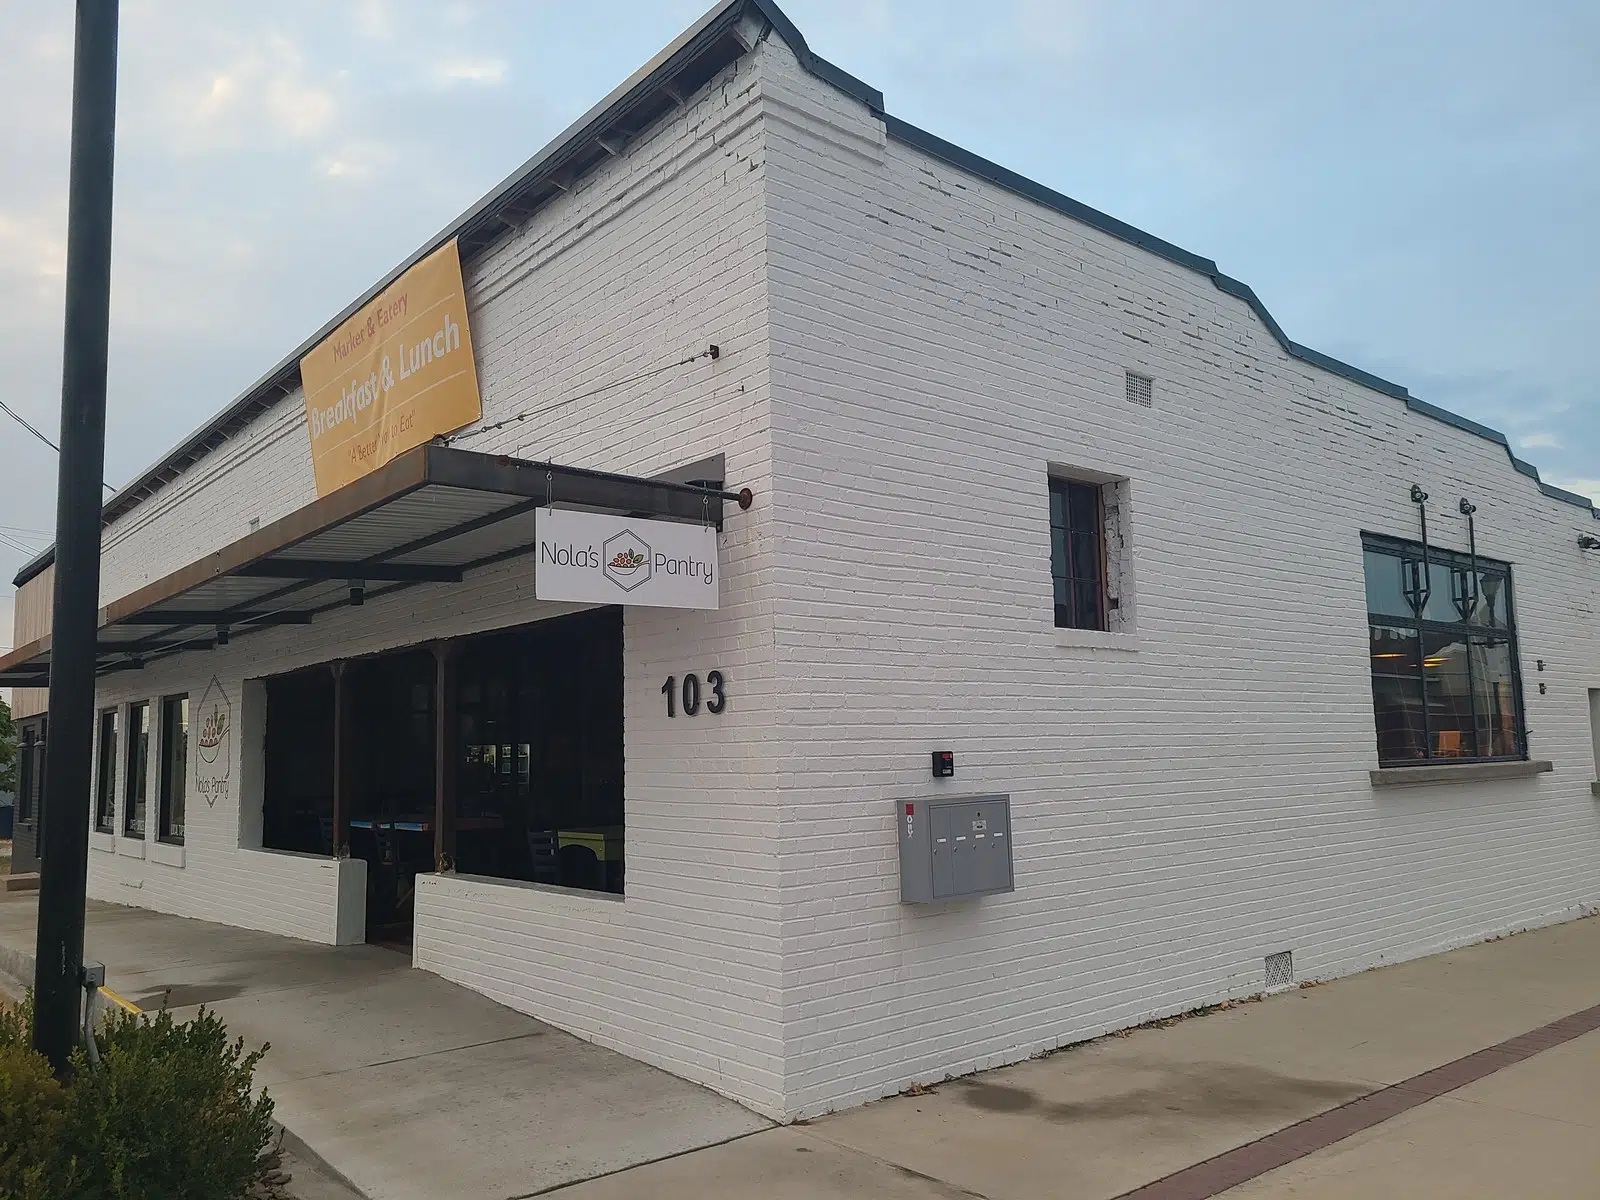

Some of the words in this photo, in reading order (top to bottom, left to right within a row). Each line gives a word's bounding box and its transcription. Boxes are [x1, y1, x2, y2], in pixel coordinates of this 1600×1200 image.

[334, 335, 366, 362] Market
[367, 316, 376, 336] &
[377, 293, 409, 328] Eatery
[311, 372, 378, 440] Breakfast
[381, 355, 395, 392] &
[399, 314, 460, 381] Lunch
[541, 541, 599, 568] Nola's
[655, 553, 713, 585] Pantry
[661, 670, 724, 718] 103
[211, 776, 230, 799] Pantry
